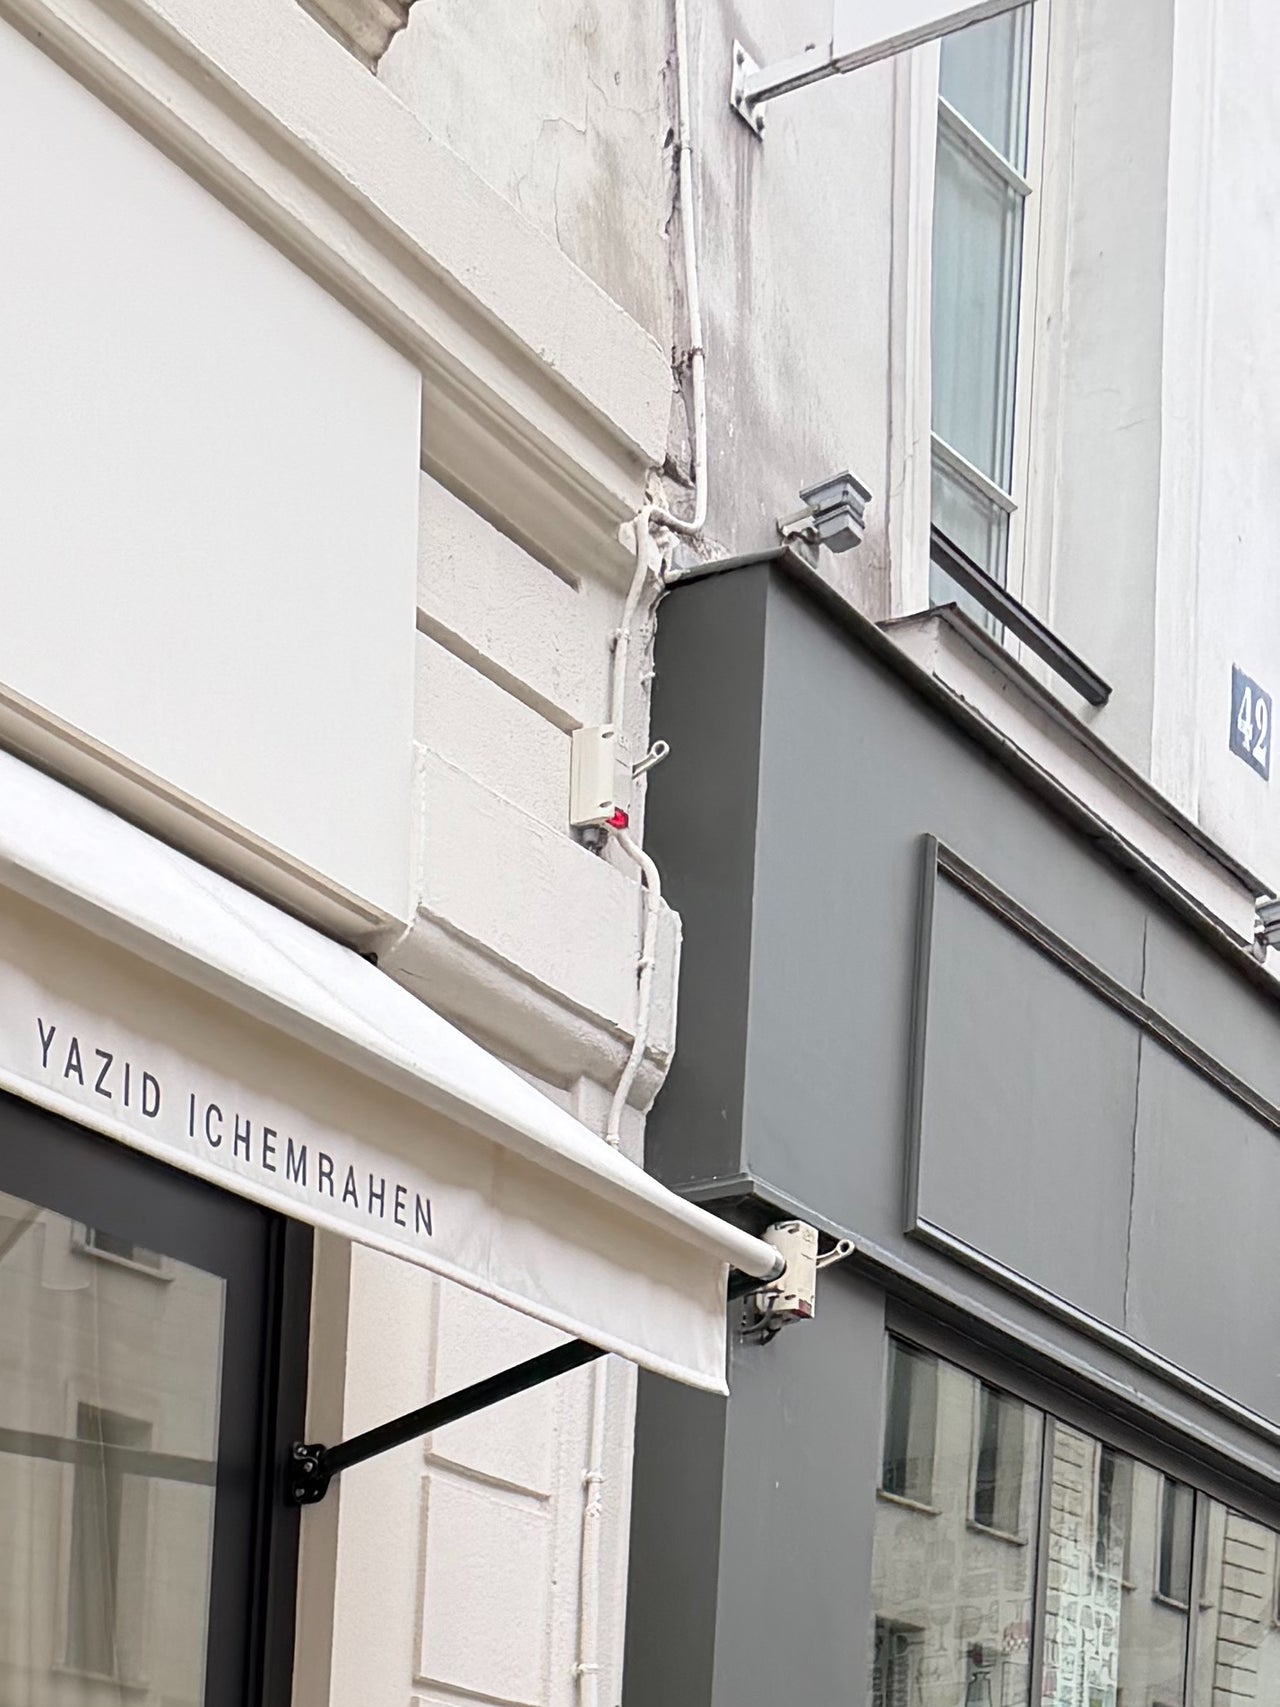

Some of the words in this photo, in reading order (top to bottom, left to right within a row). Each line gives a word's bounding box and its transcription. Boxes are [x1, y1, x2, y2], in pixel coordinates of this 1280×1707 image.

[1237, 686, 1268, 768] 42
[36, 1017, 161, 1118] YAZID
[188, 1093, 434, 1237] ICHEMRAHEN
